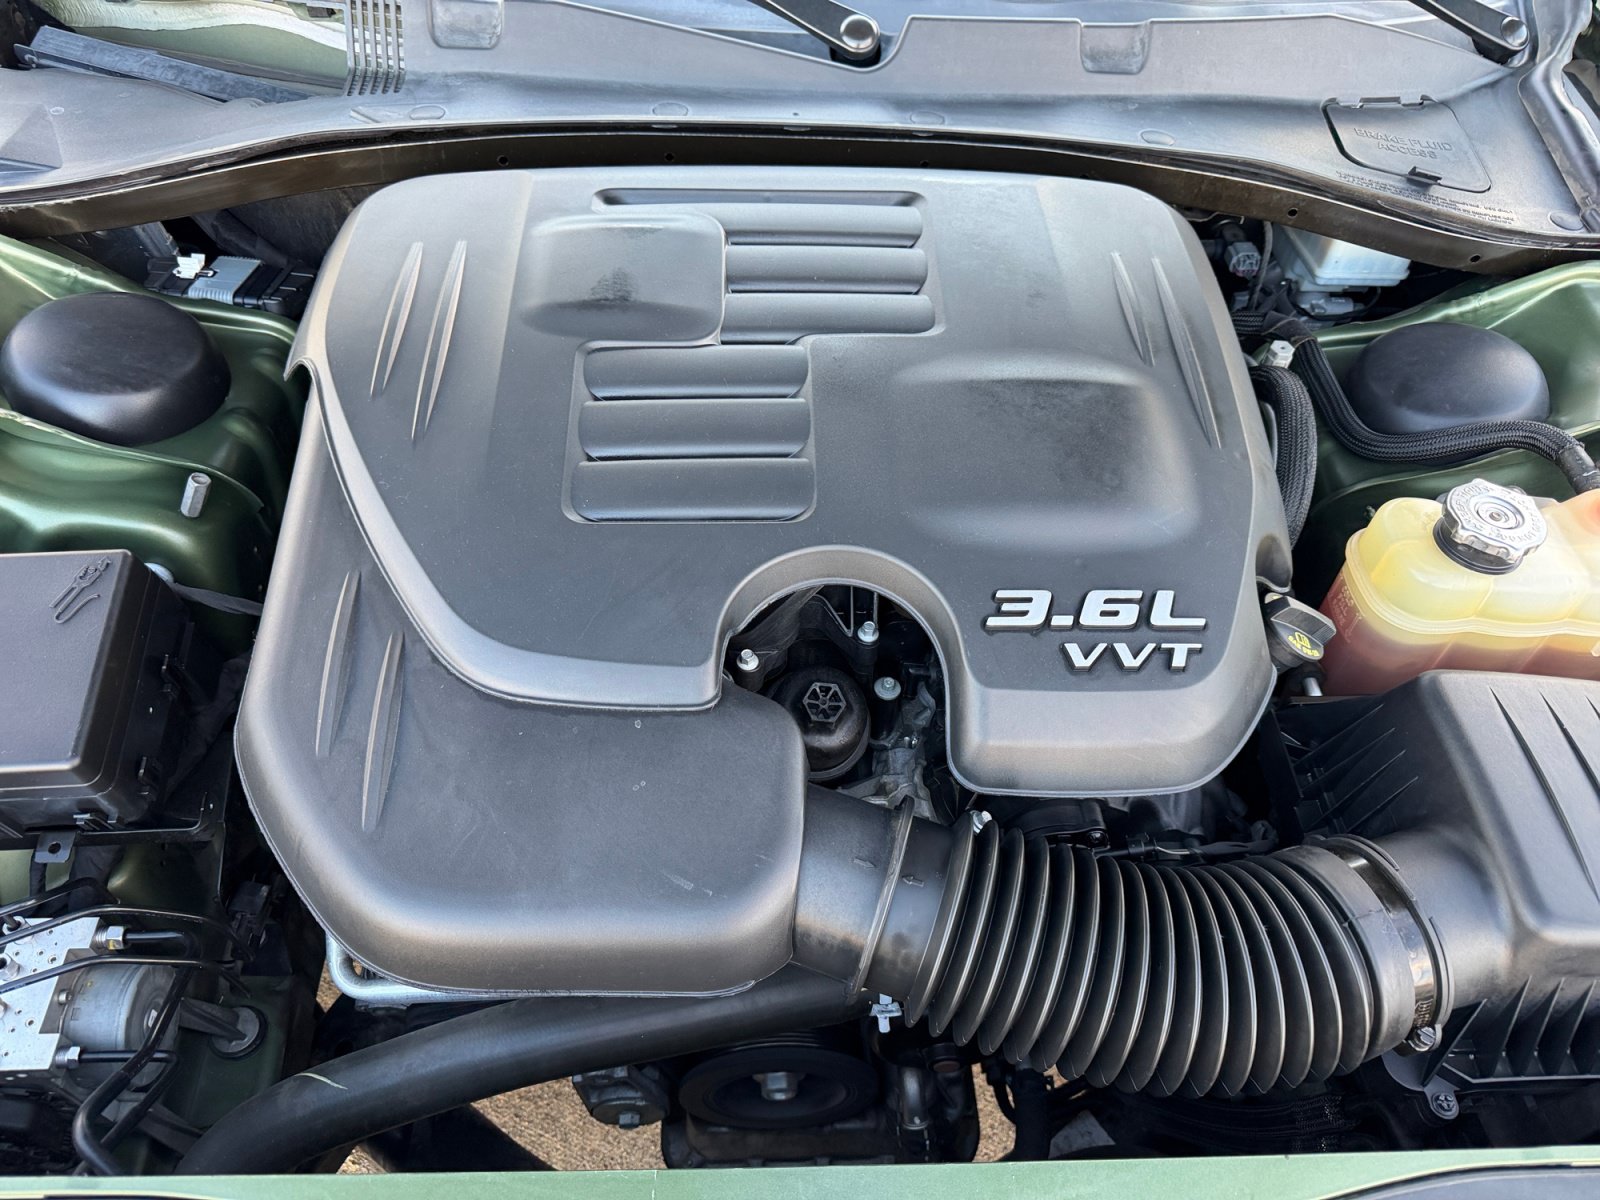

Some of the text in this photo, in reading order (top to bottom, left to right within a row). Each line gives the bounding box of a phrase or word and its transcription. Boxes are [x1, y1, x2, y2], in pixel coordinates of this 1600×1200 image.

[1354, 128, 1453, 152] BRAKE FLUID
[1378, 142, 1437, 159] ACCESS
[984, 589, 1207, 631] 3.6L
[1062, 642, 1203, 672] VVT
